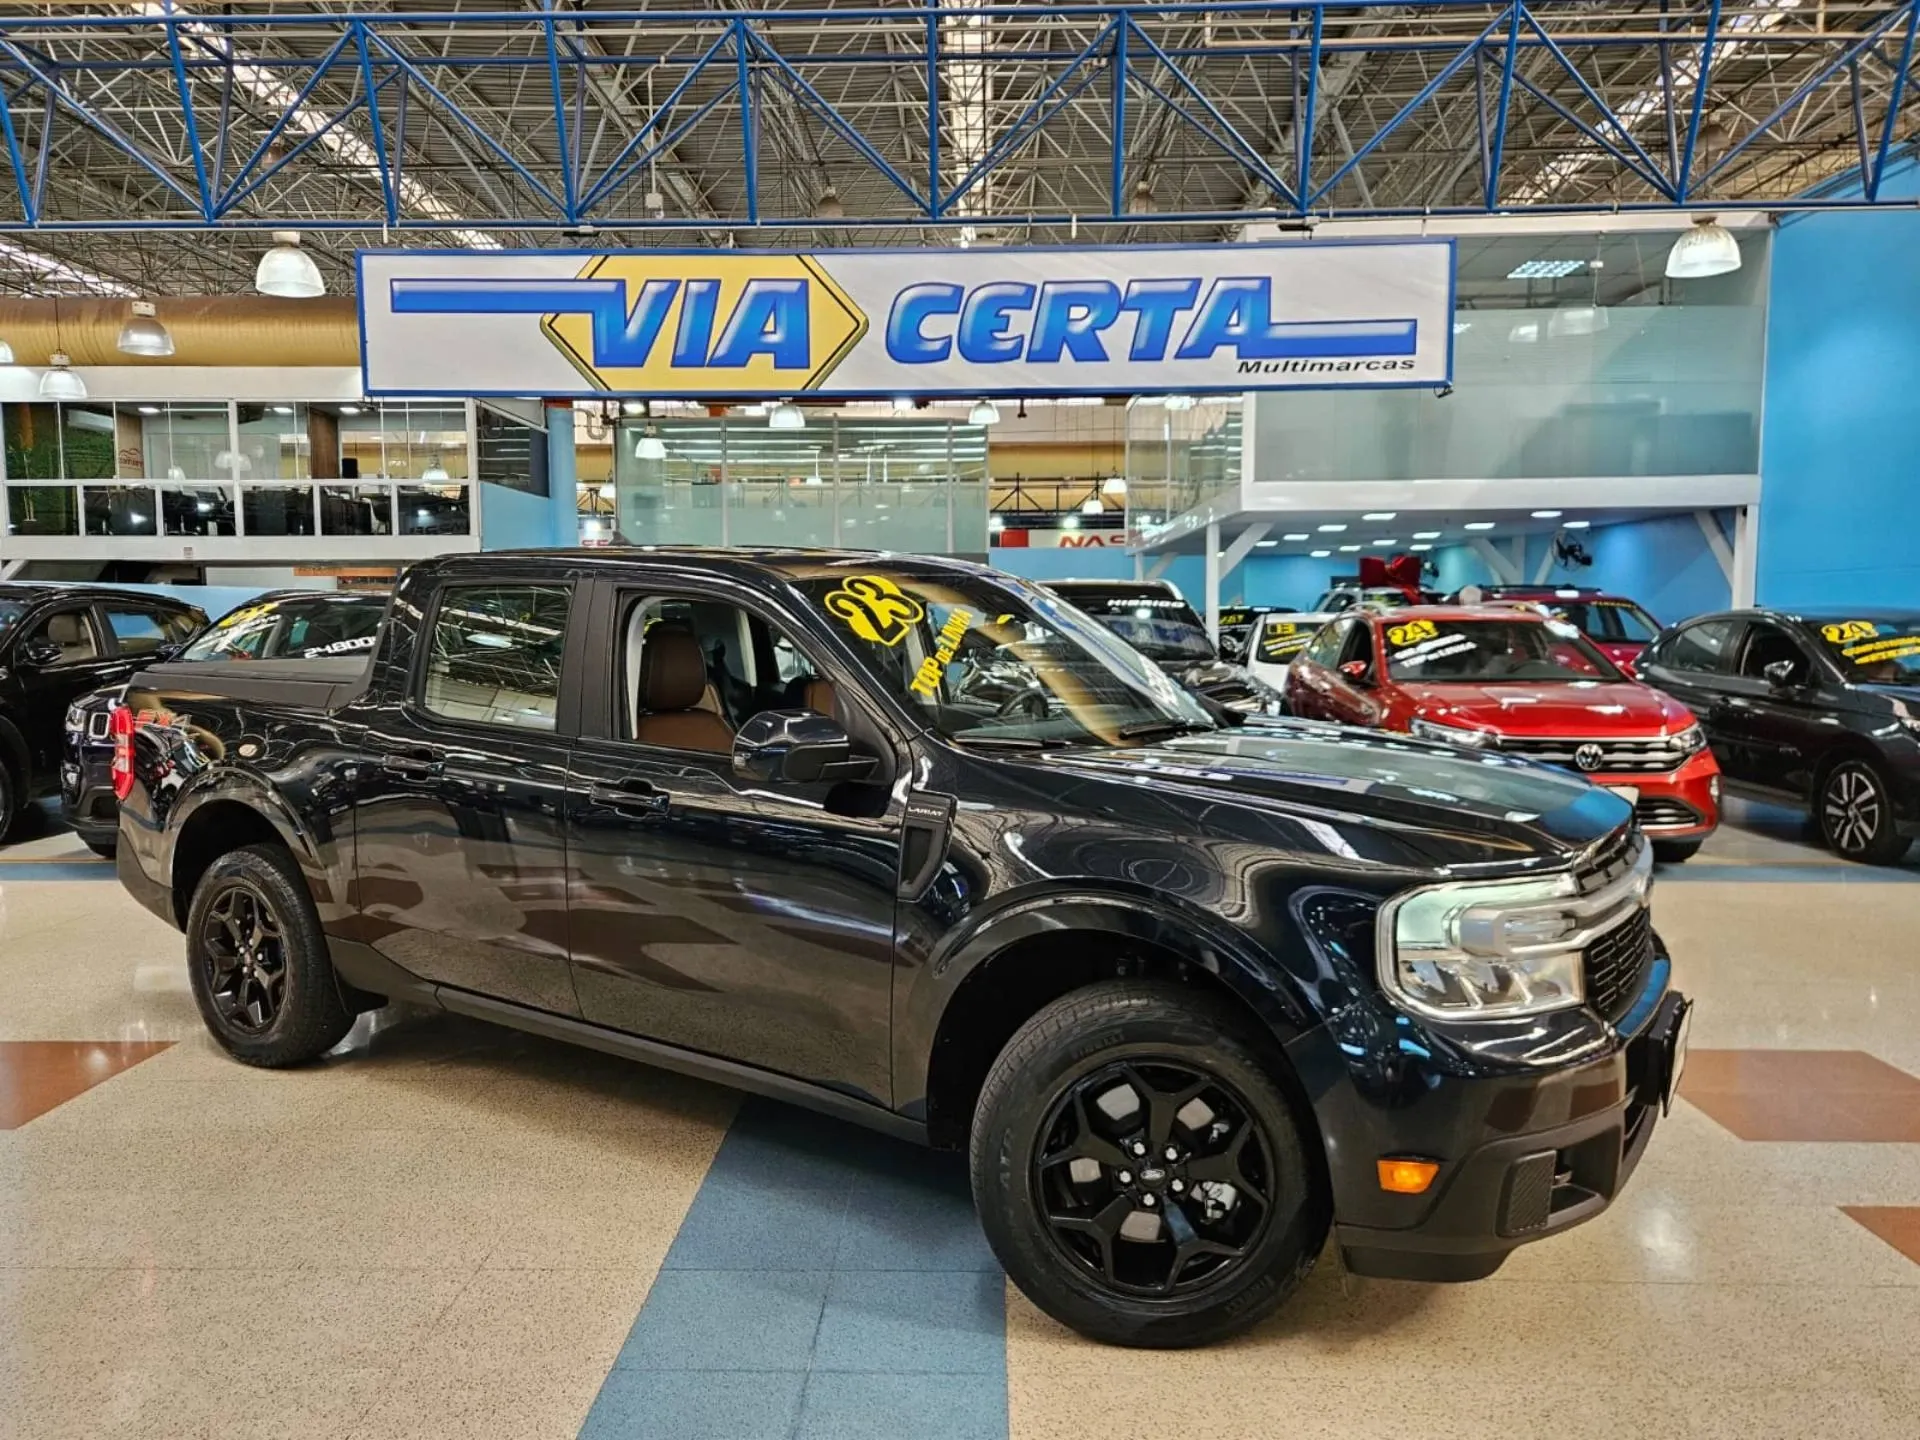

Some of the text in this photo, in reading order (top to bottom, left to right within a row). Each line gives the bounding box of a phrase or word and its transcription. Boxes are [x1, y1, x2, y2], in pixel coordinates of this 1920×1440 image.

[886, 276, 1417, 364] CERTA
[1238, 355, 1416, 375] Multimarcas
[825, 576, 924, 646] 23
[304, 636, 376, 659] 24.800
[910, 607, 973, 697] TOP DE LINHA
[907, 806, 944, 817] LARIAT
